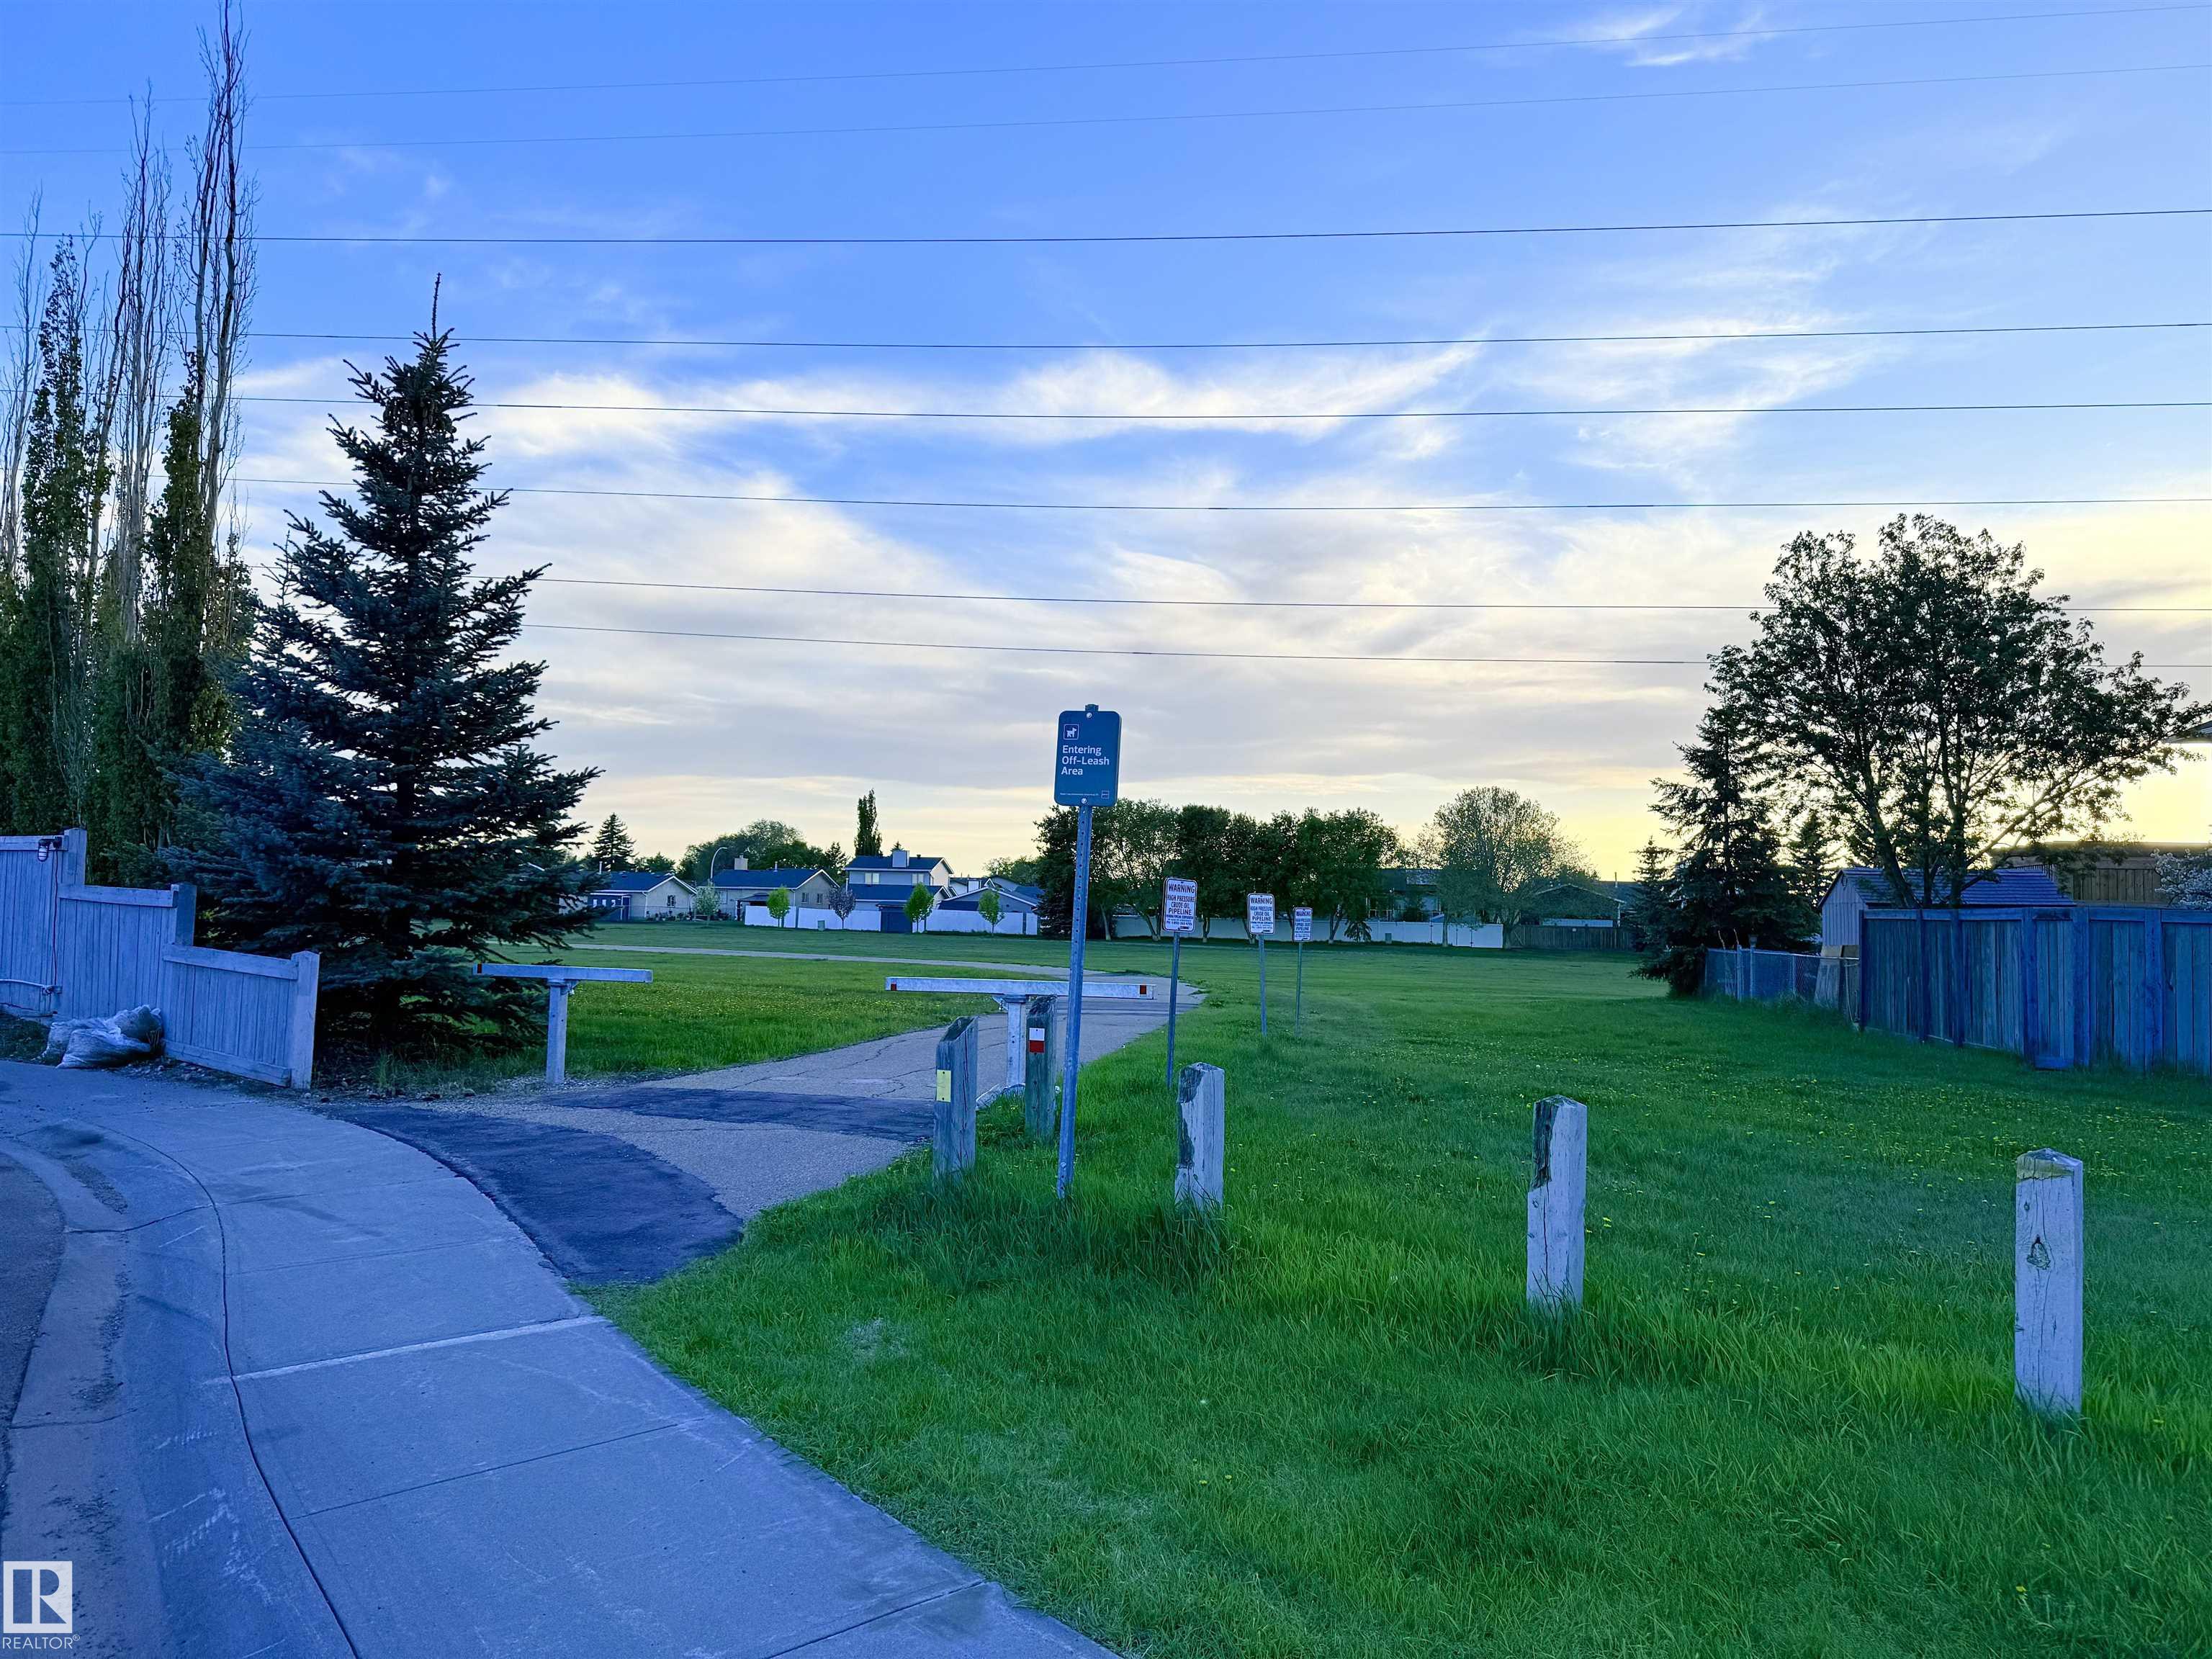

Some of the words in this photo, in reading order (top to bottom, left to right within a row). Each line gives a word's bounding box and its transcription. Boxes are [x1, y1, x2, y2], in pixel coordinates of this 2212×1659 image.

[1062, 745, 1102, 756] Entering
[1061, 756, 1110, 765] Off-Leash
[1061, 766, 1083, 775] Area
[1169, 883, 1195, 894] WARNING
